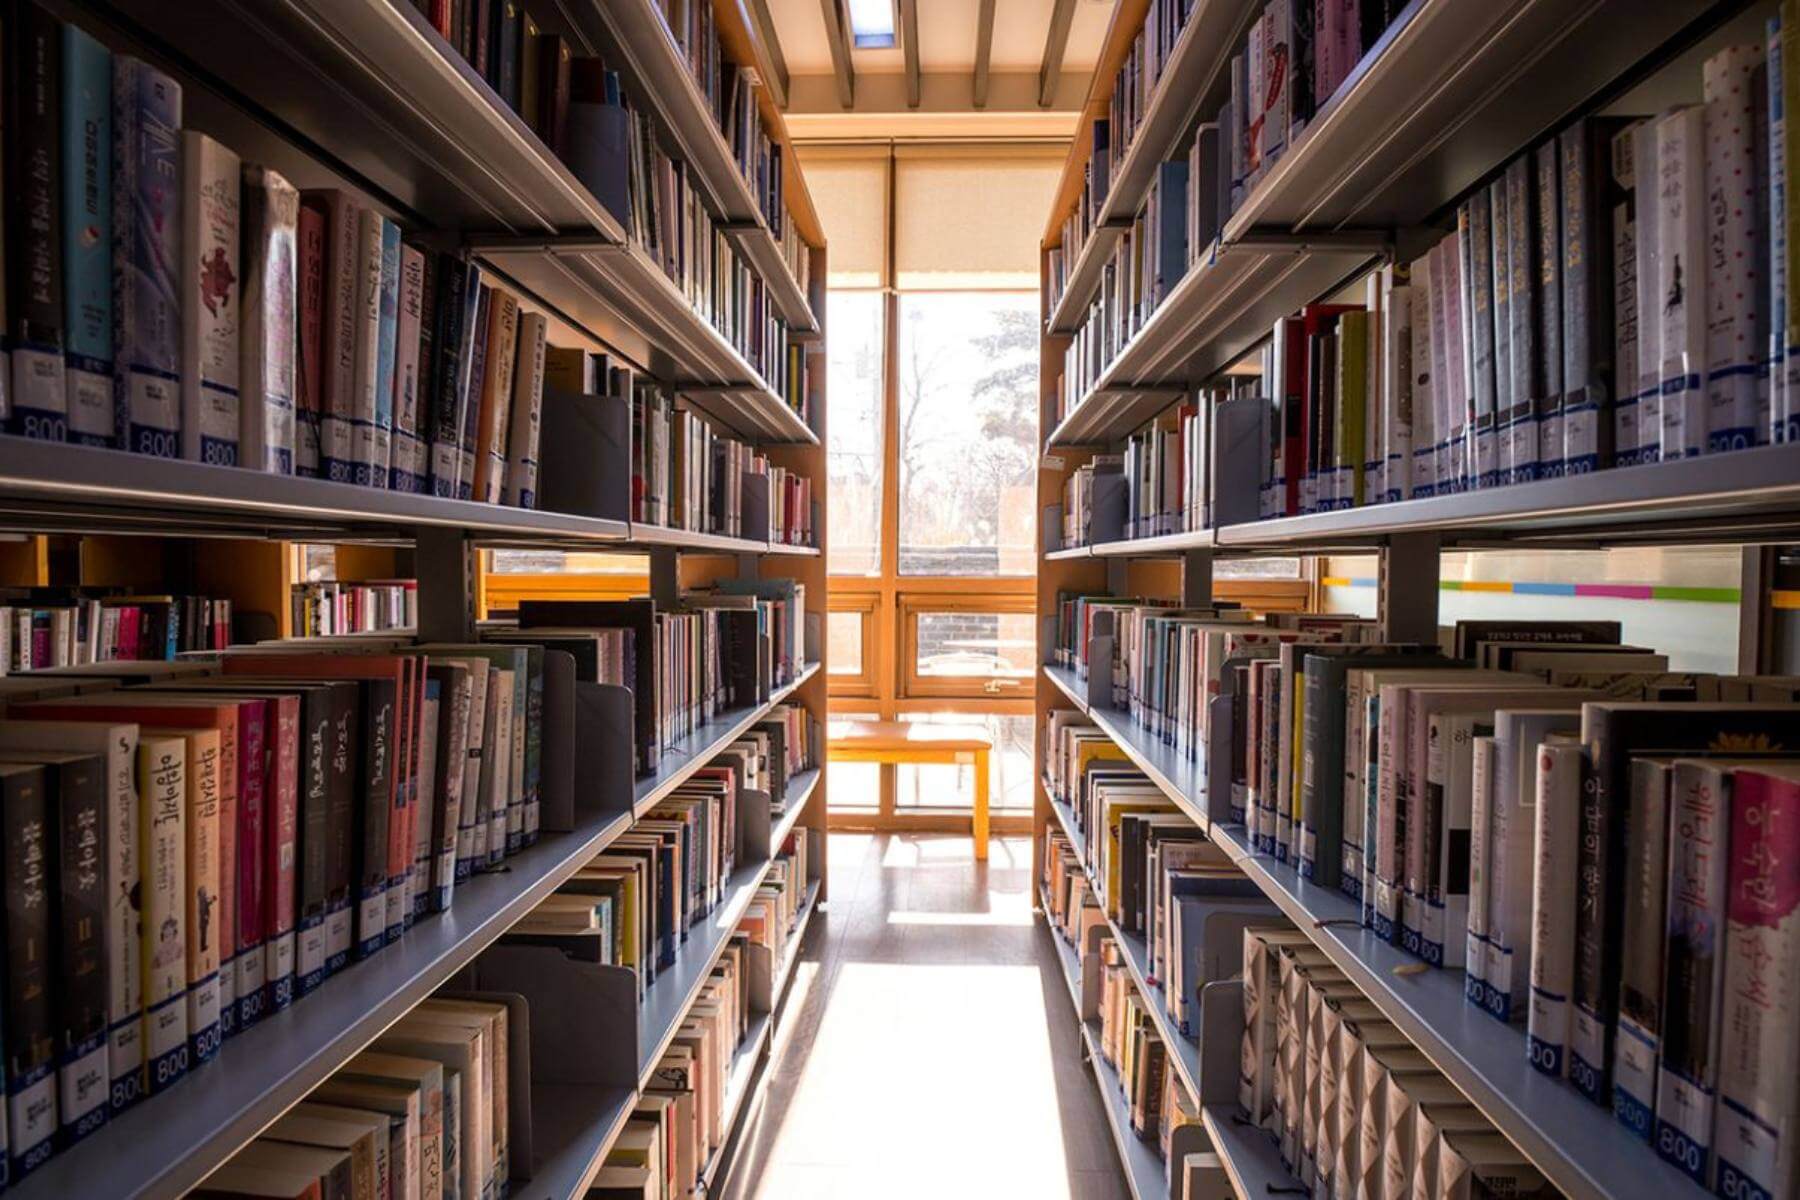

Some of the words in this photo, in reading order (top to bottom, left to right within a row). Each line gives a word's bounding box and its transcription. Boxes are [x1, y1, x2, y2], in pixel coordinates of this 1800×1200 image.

[205, 443, 235, 467] 800
[158, 1047, 189, 1083] 800
[1660, 1127, 1701, 1171] 800
